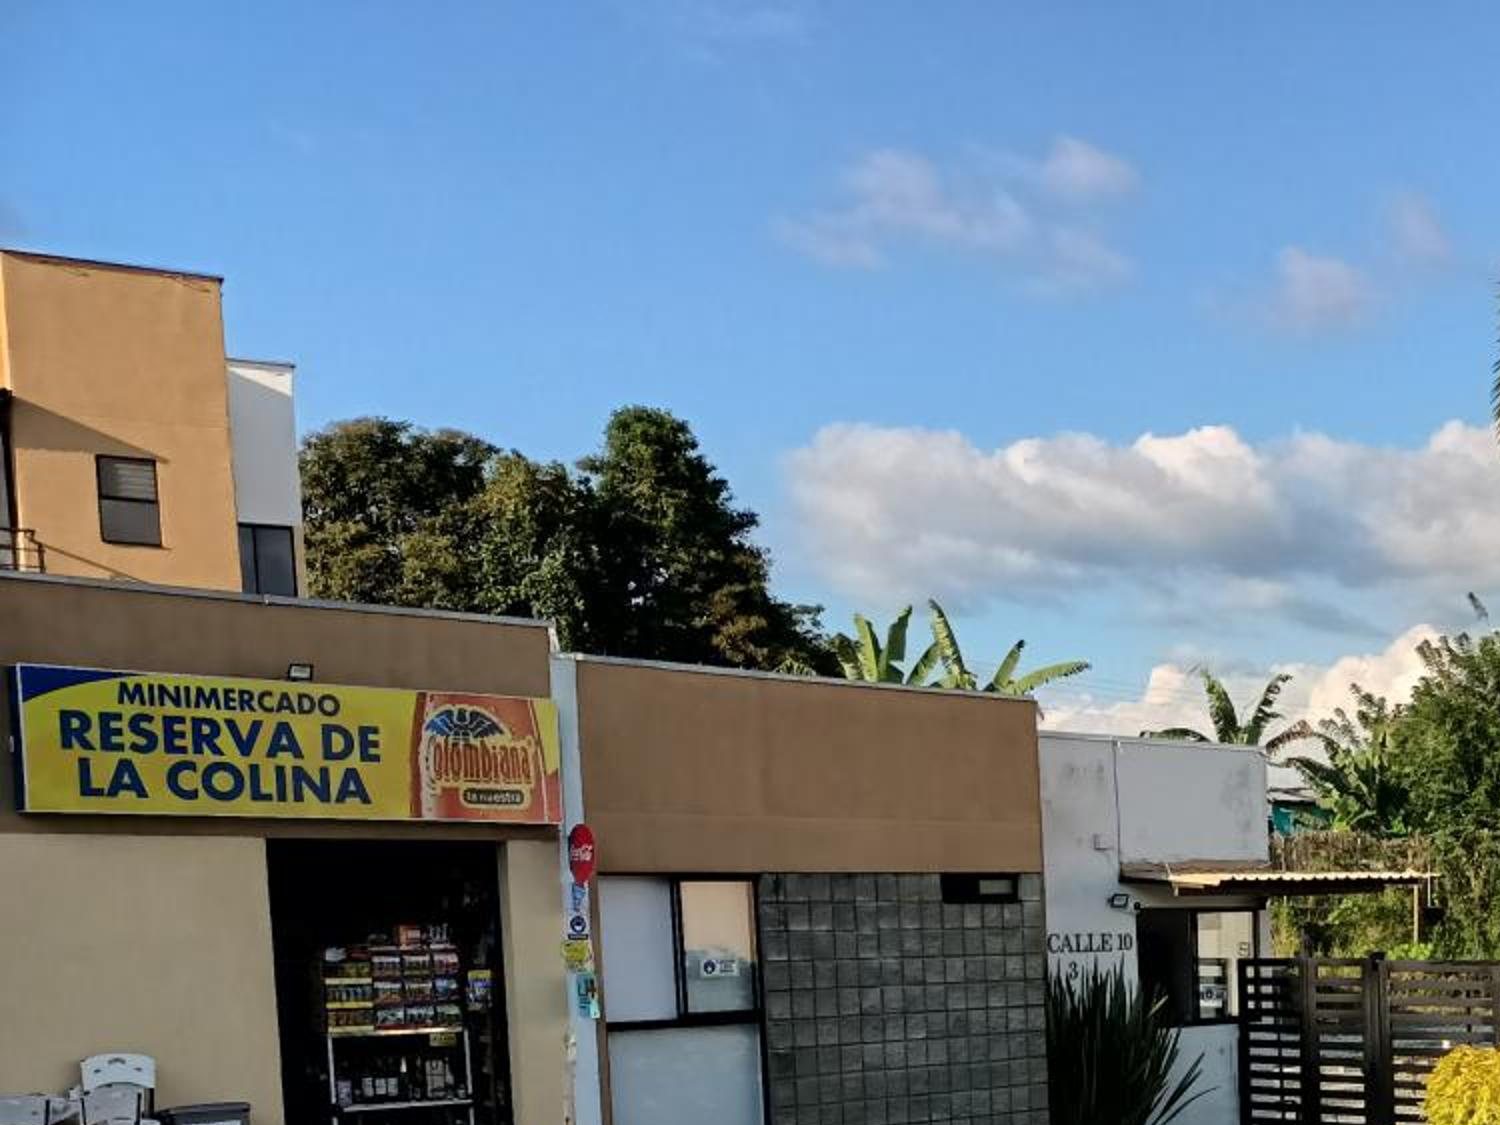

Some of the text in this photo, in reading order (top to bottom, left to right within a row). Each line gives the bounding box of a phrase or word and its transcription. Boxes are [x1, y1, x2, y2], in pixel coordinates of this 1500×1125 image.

[117, 681, 341, 717] MINIMERCADO
[59, 709, 381, 763] RESERVA DE
[78, 757, 372, 804] LA COLINA
[1047, 933, 1133, 953] CALLE 10
